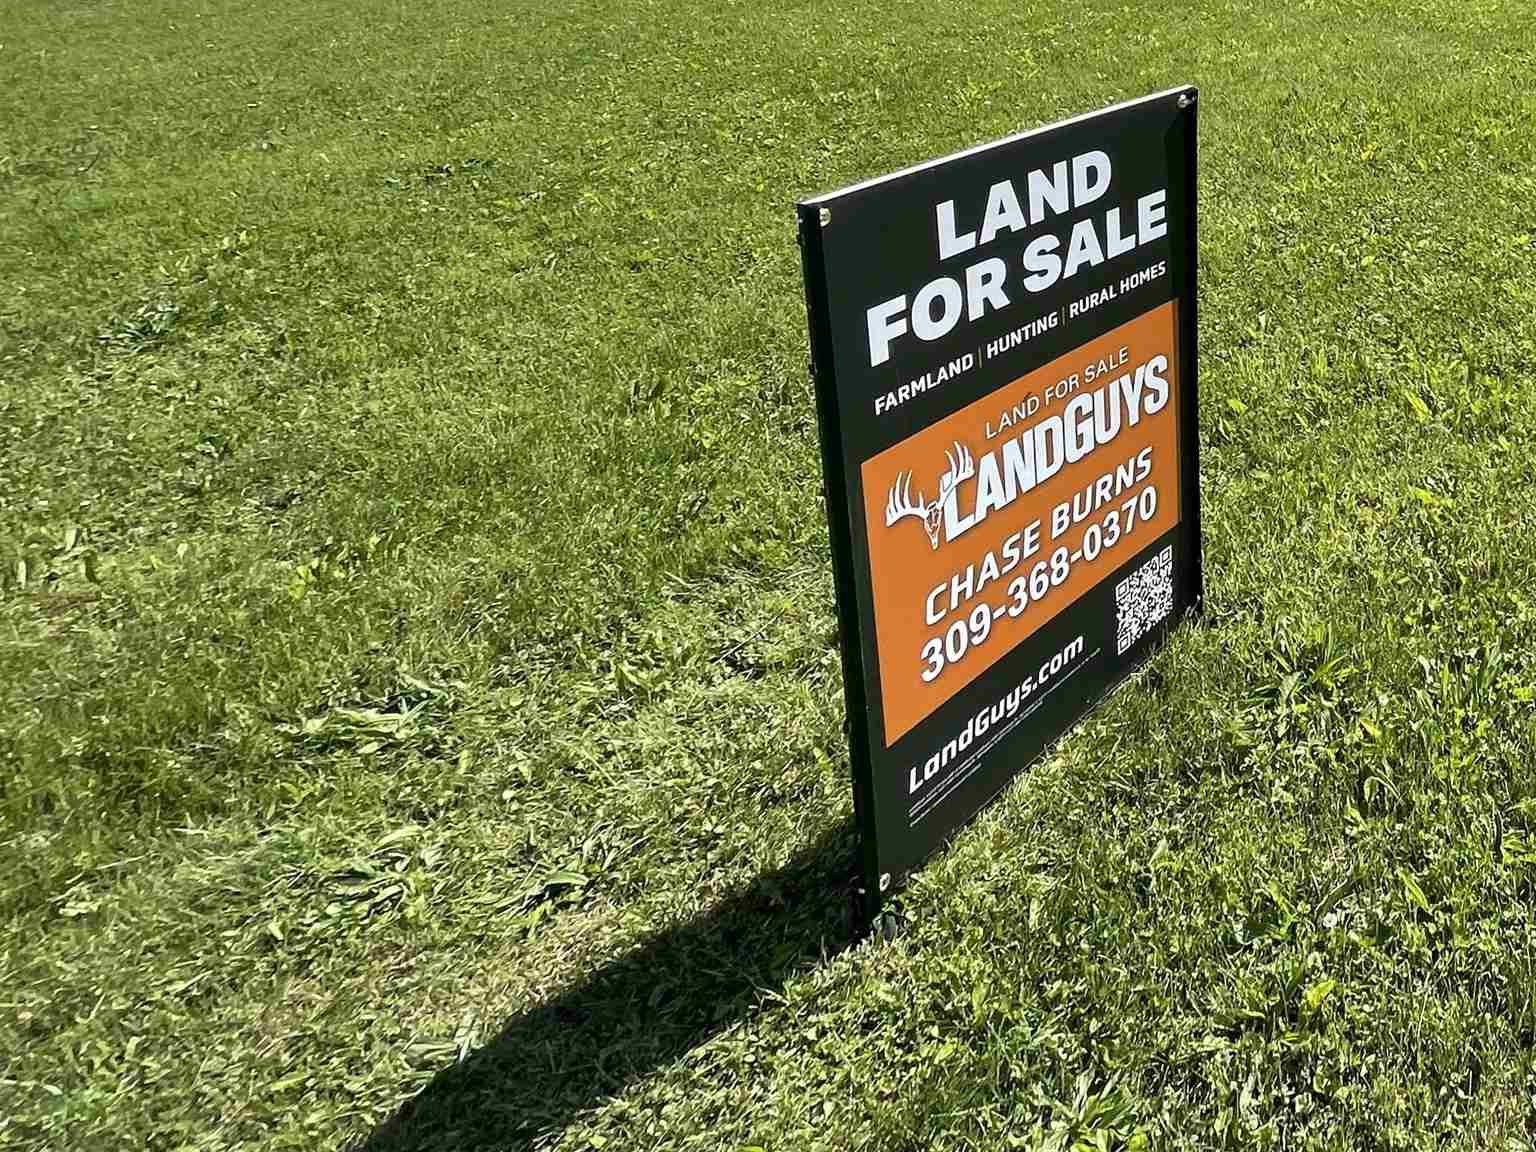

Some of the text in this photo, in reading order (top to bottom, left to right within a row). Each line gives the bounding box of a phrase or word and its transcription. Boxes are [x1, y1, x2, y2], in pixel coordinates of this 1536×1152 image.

[866, 189, 1168, 367] FOR SALE
[936, 150, 1112, 260] LAND
[874, 260, 1167, 415] FARMLAND HUNTING RURAL HOMES
[985, 346, 1129, 440] LAND FOR SALE
[942, 354, 1169, 542] LANDGUYS
[920, 485, 1158, 683] 309-368-0370
[925, 446, 1153, 626] CHASE BURNS
[908, 634, 1085, 795] LandGuys.com
